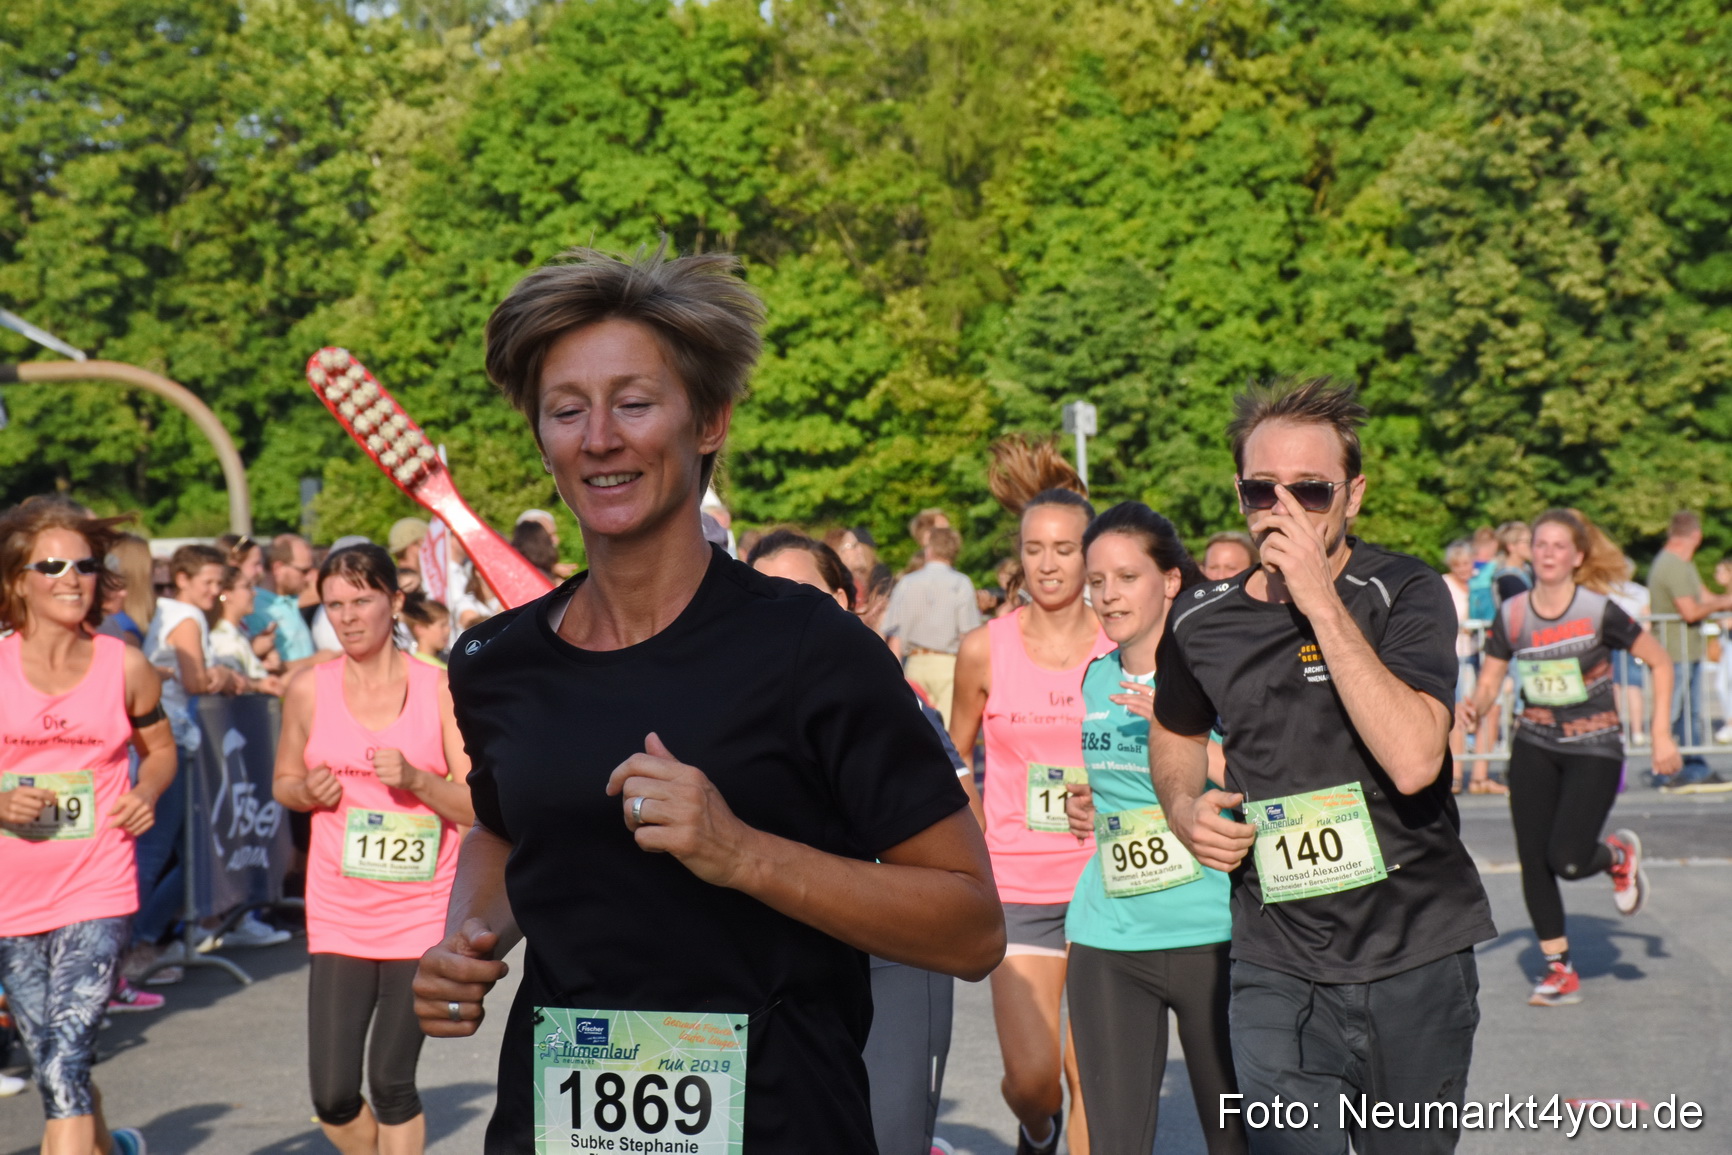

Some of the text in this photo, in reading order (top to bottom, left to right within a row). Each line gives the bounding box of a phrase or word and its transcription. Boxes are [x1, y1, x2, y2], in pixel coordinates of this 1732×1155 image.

[1532, 676, 1568, 692] 973
[1049, 690, 1075, 706] Die
[43, 714, 68, 730] Die
[1117, 743, 1143, 753] GmbH
[1261, 813, 1304, 831] firmenlauf
[1335, 811, 1359, 823] 2019
[356, 834, 426, 862] 1123
[1112, 836, 1169, 873] 968
[1275, 827, 1344, 870] 140
[1140, 863, 1183, 877] Alexandra
[1266, 882, 1303, 893] Berschneider
[1308, 872, 1353, 887] Berschneider
[1354, 866, 1377, 877] GmbH
[1273, 860, 1363, 883] Novosad Alexander
[562, 1040, 641, 1060] firmenlauf
[658, 1058, 731, 1073] run 2019
[559, 1070, 713, 1136] 1869
[570, 1133, 699, 1155] Subke Stephanie
